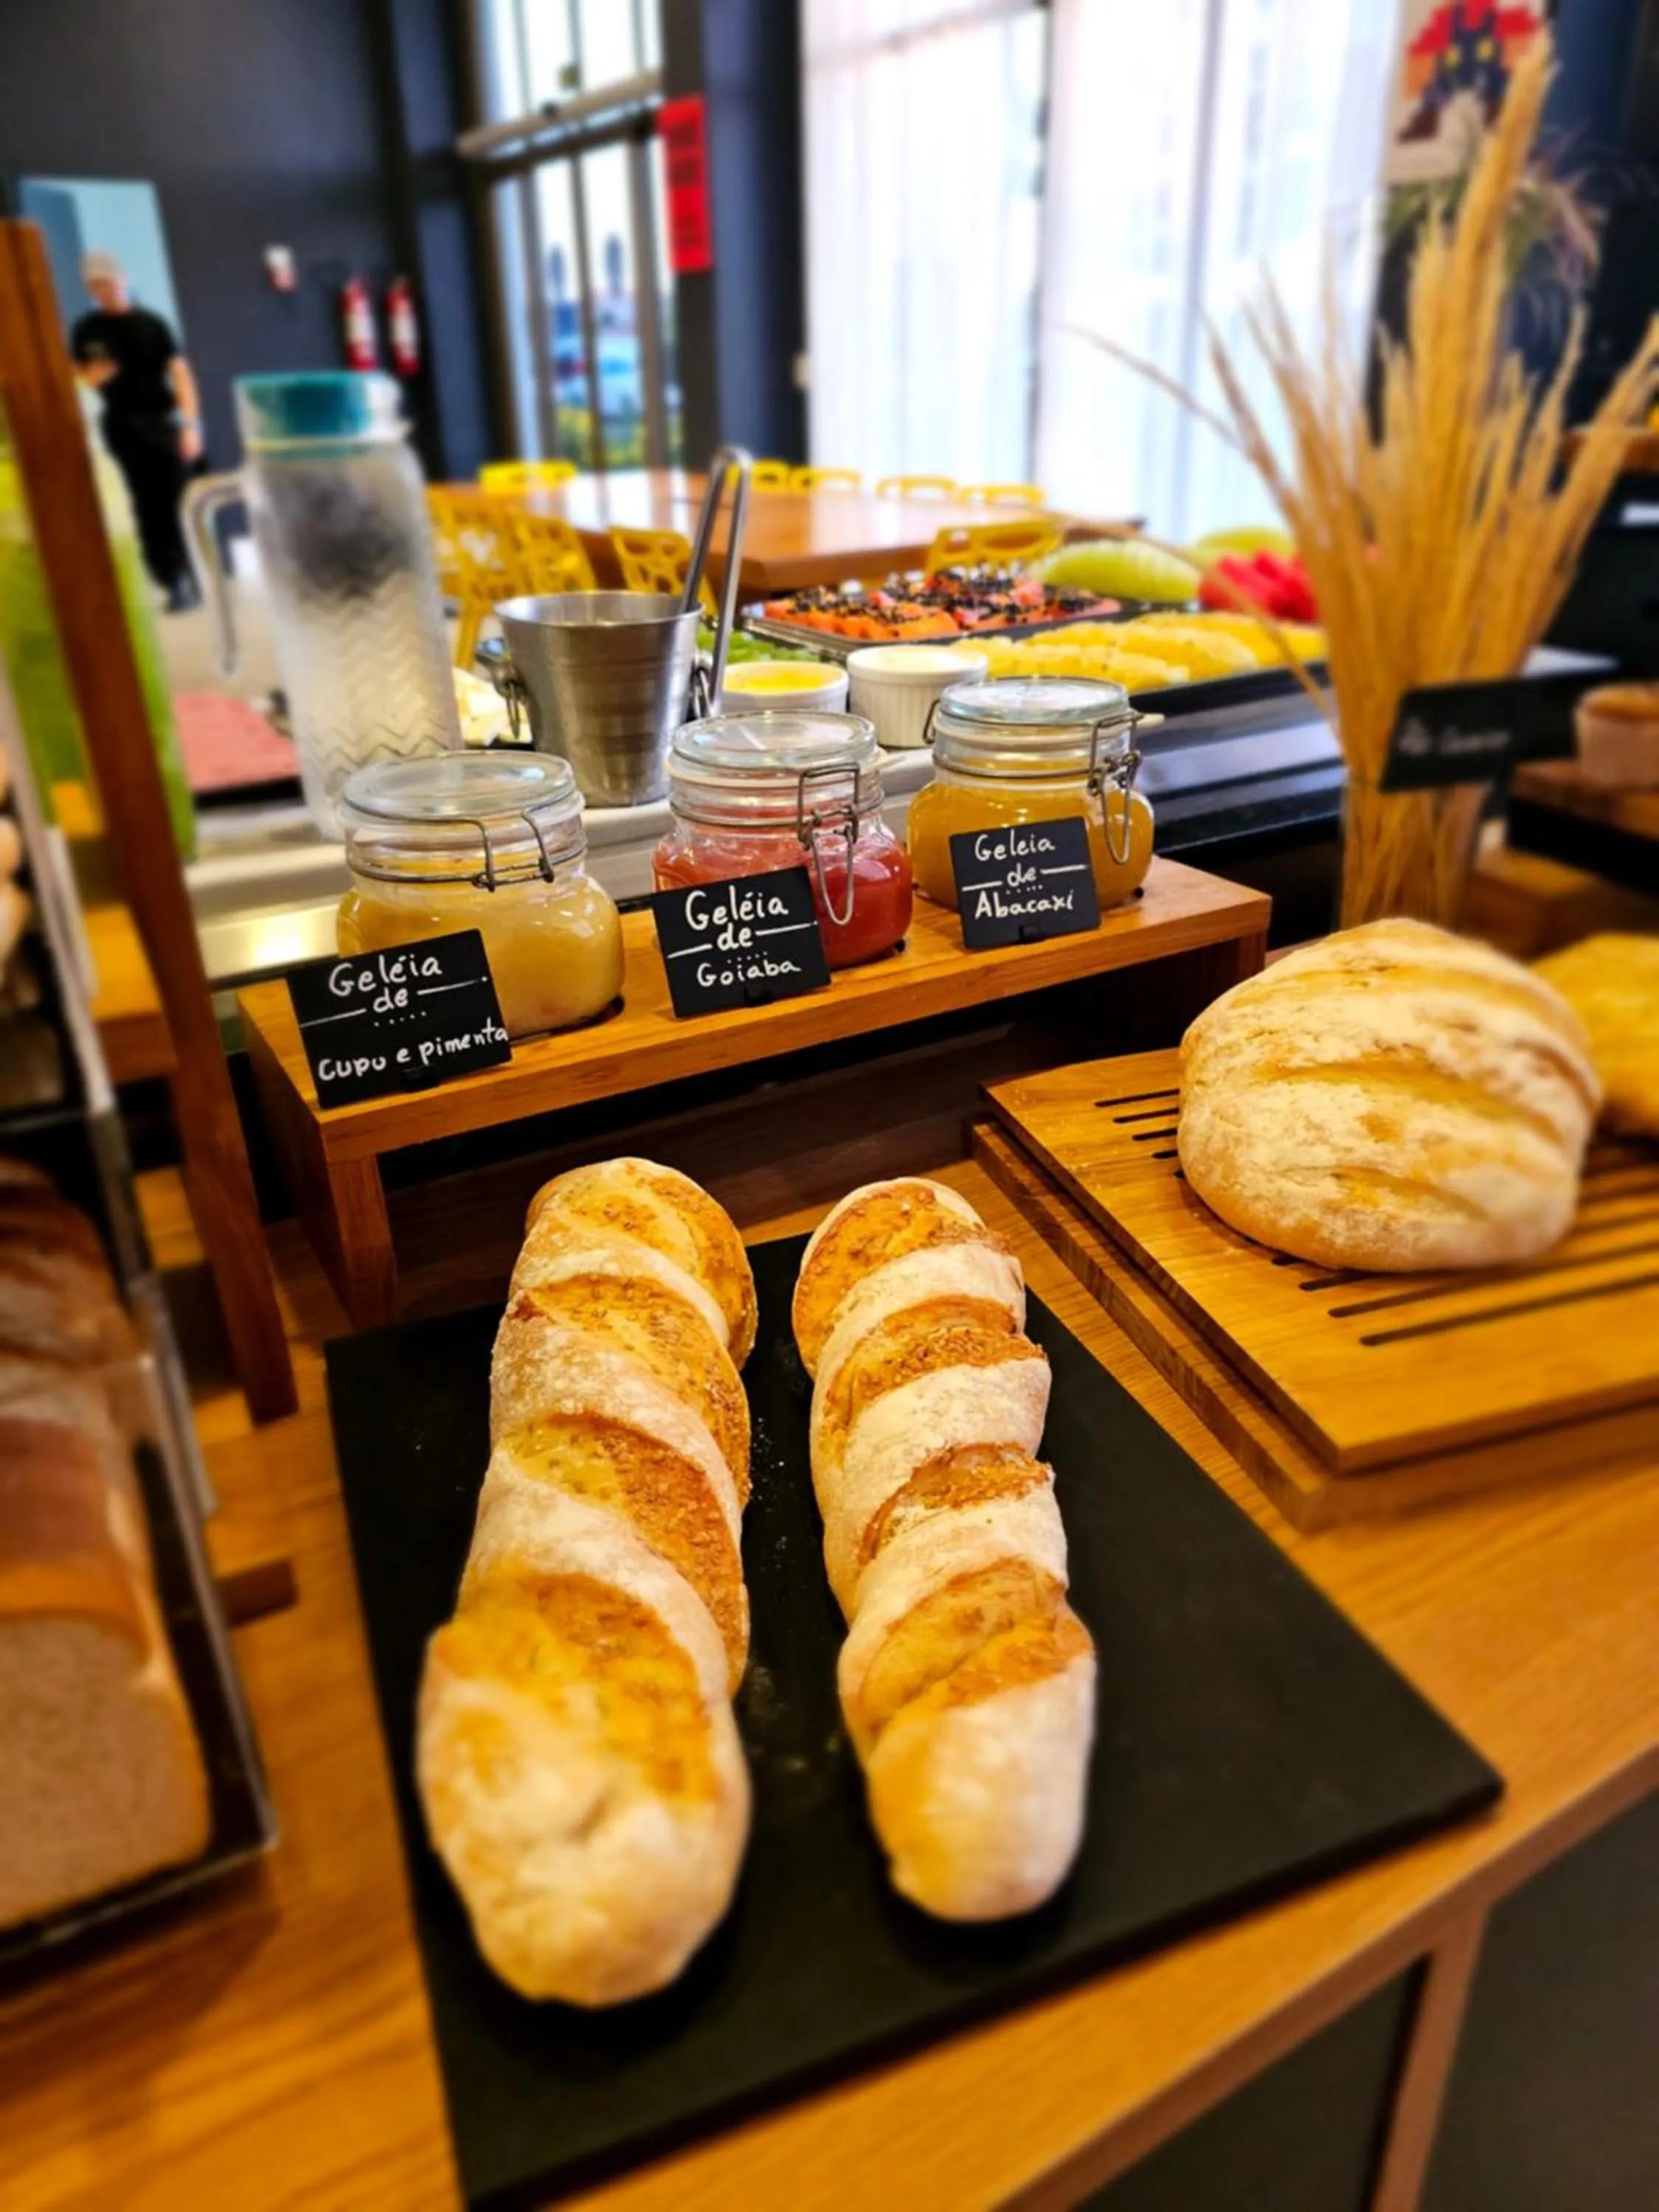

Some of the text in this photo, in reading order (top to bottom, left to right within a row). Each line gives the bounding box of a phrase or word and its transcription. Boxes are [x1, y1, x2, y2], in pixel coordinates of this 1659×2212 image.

[975, 829, 1055, 860] Geleia
[1007, 863, 1036, 887] de
[685, 885, 789, 931] Geléia
[717, 922, 753, 950] de
[329, 954, 442, 996] Geléia
[697, 959, 801, 987] Goiaba
[373, 987, 408, 1012] de
[396, 1048, 411, 1062] e
[418, 1016, 509, 1065] pimenta
